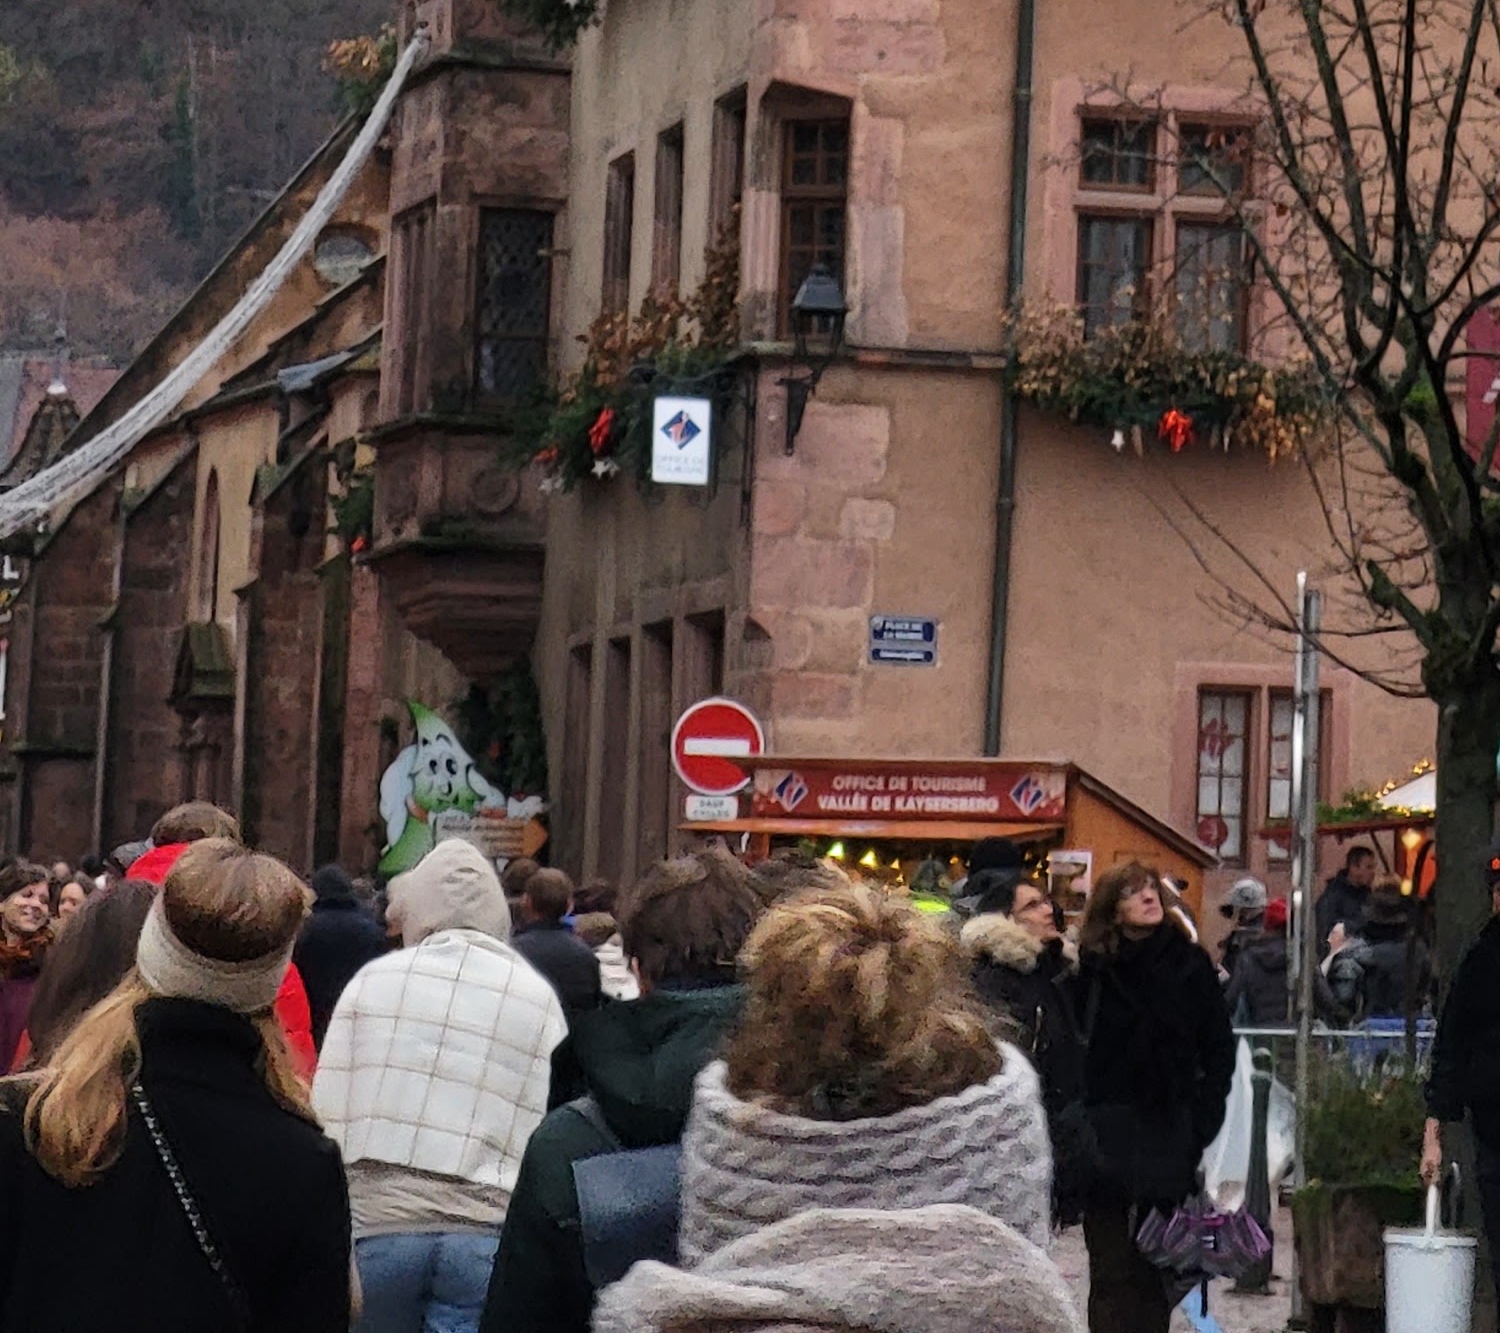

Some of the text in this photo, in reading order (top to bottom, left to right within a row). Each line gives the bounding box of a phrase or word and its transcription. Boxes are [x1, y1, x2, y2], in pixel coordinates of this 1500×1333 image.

[832, 775, 987, 792] OFFICE DE TOURISME
[817, 792, 1000, 813] VALLÉE DE KAYSERSBERG
